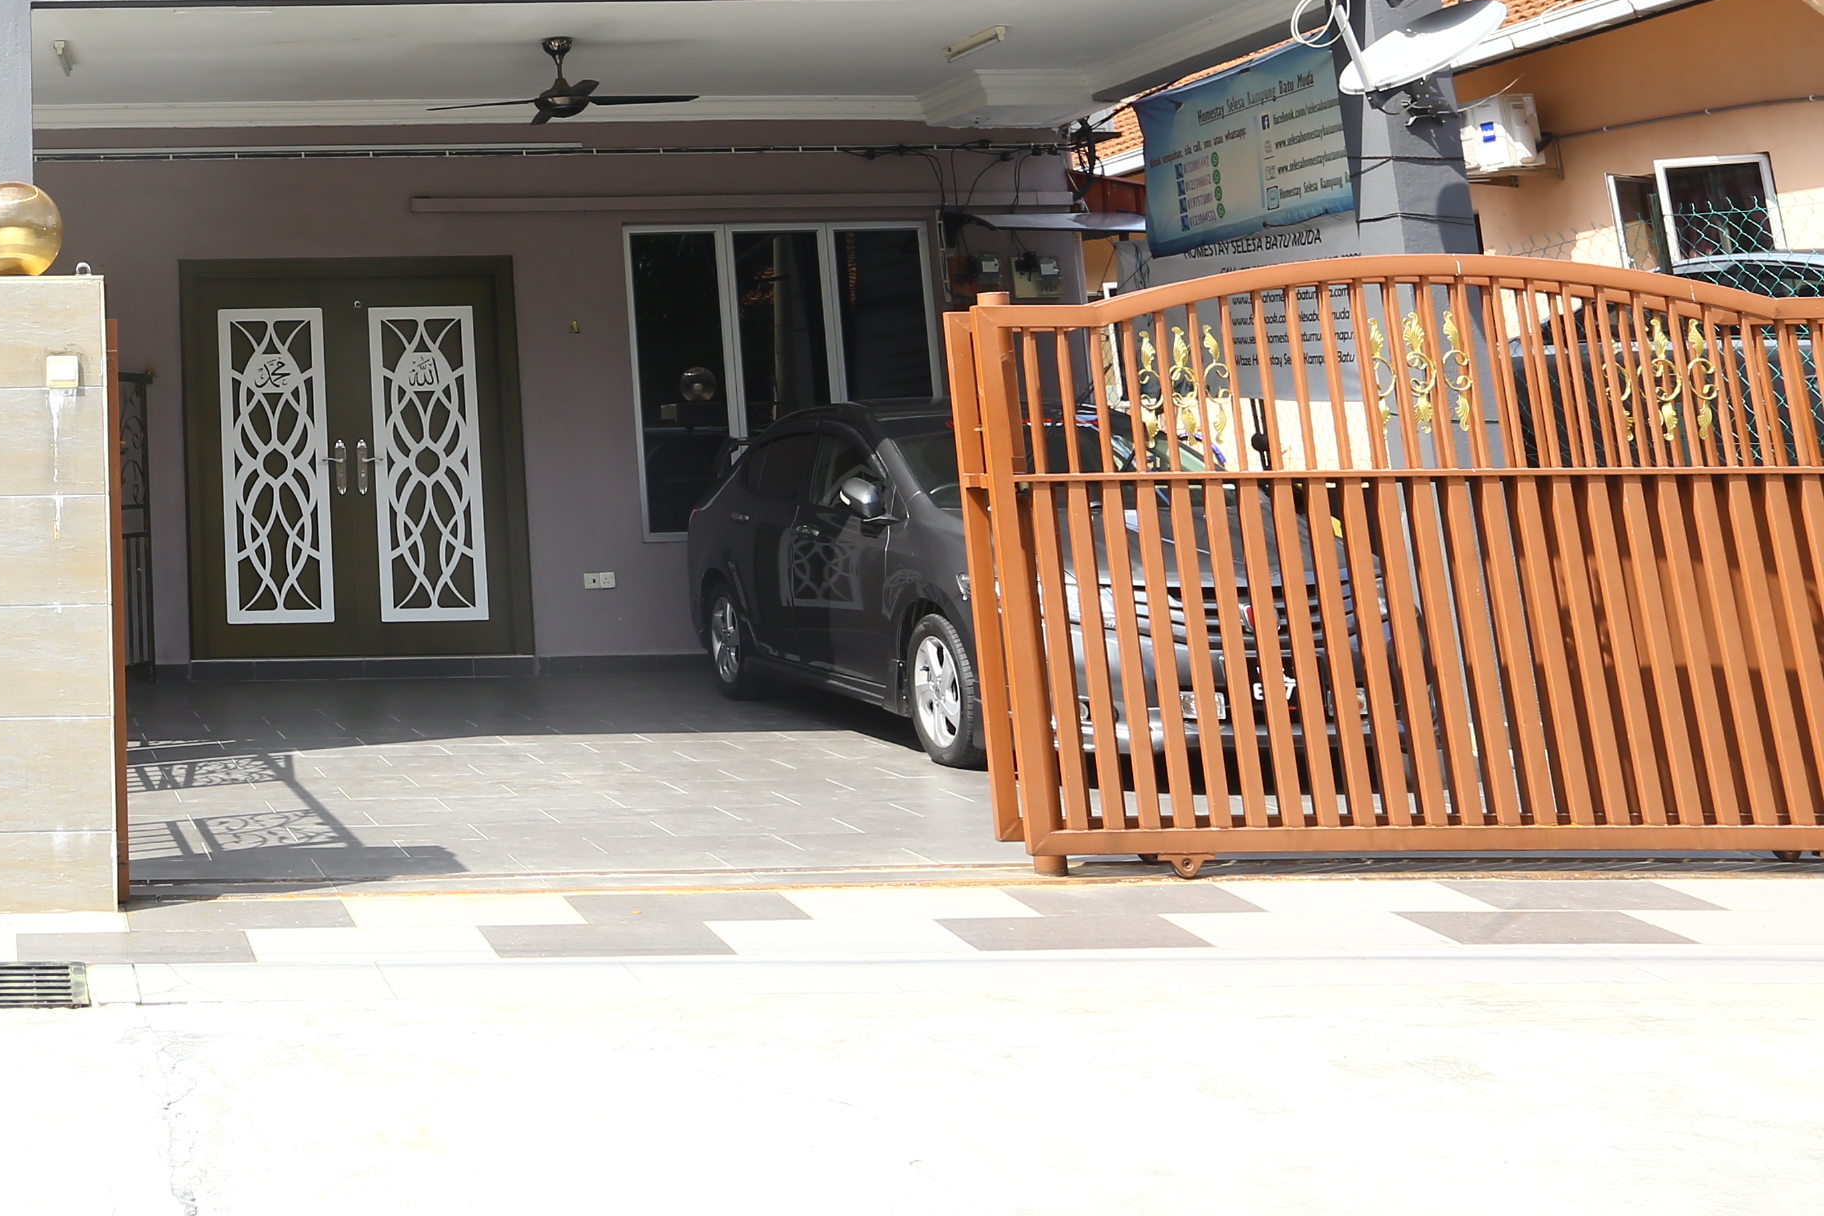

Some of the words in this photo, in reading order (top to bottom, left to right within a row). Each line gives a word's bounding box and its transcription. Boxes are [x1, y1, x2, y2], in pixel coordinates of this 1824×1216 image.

[1197, 104, 1225, 124] Homestay
[1226, 96, 1246, 113] Selesa
[1246, 85, 1277, 105] Kampung
[1278, 79, 1295, 95] Batu
[1297, 70, 1314, 89] Muda
[1303, 181, 1319, 194] Selesa
[1319, 175, 1343, 191] Kampung
[1232, 237, 1263, 254] SELESA
[1265, 234, 1289, 251] BATU
[1292, 228, 1322, 246] MUDA
